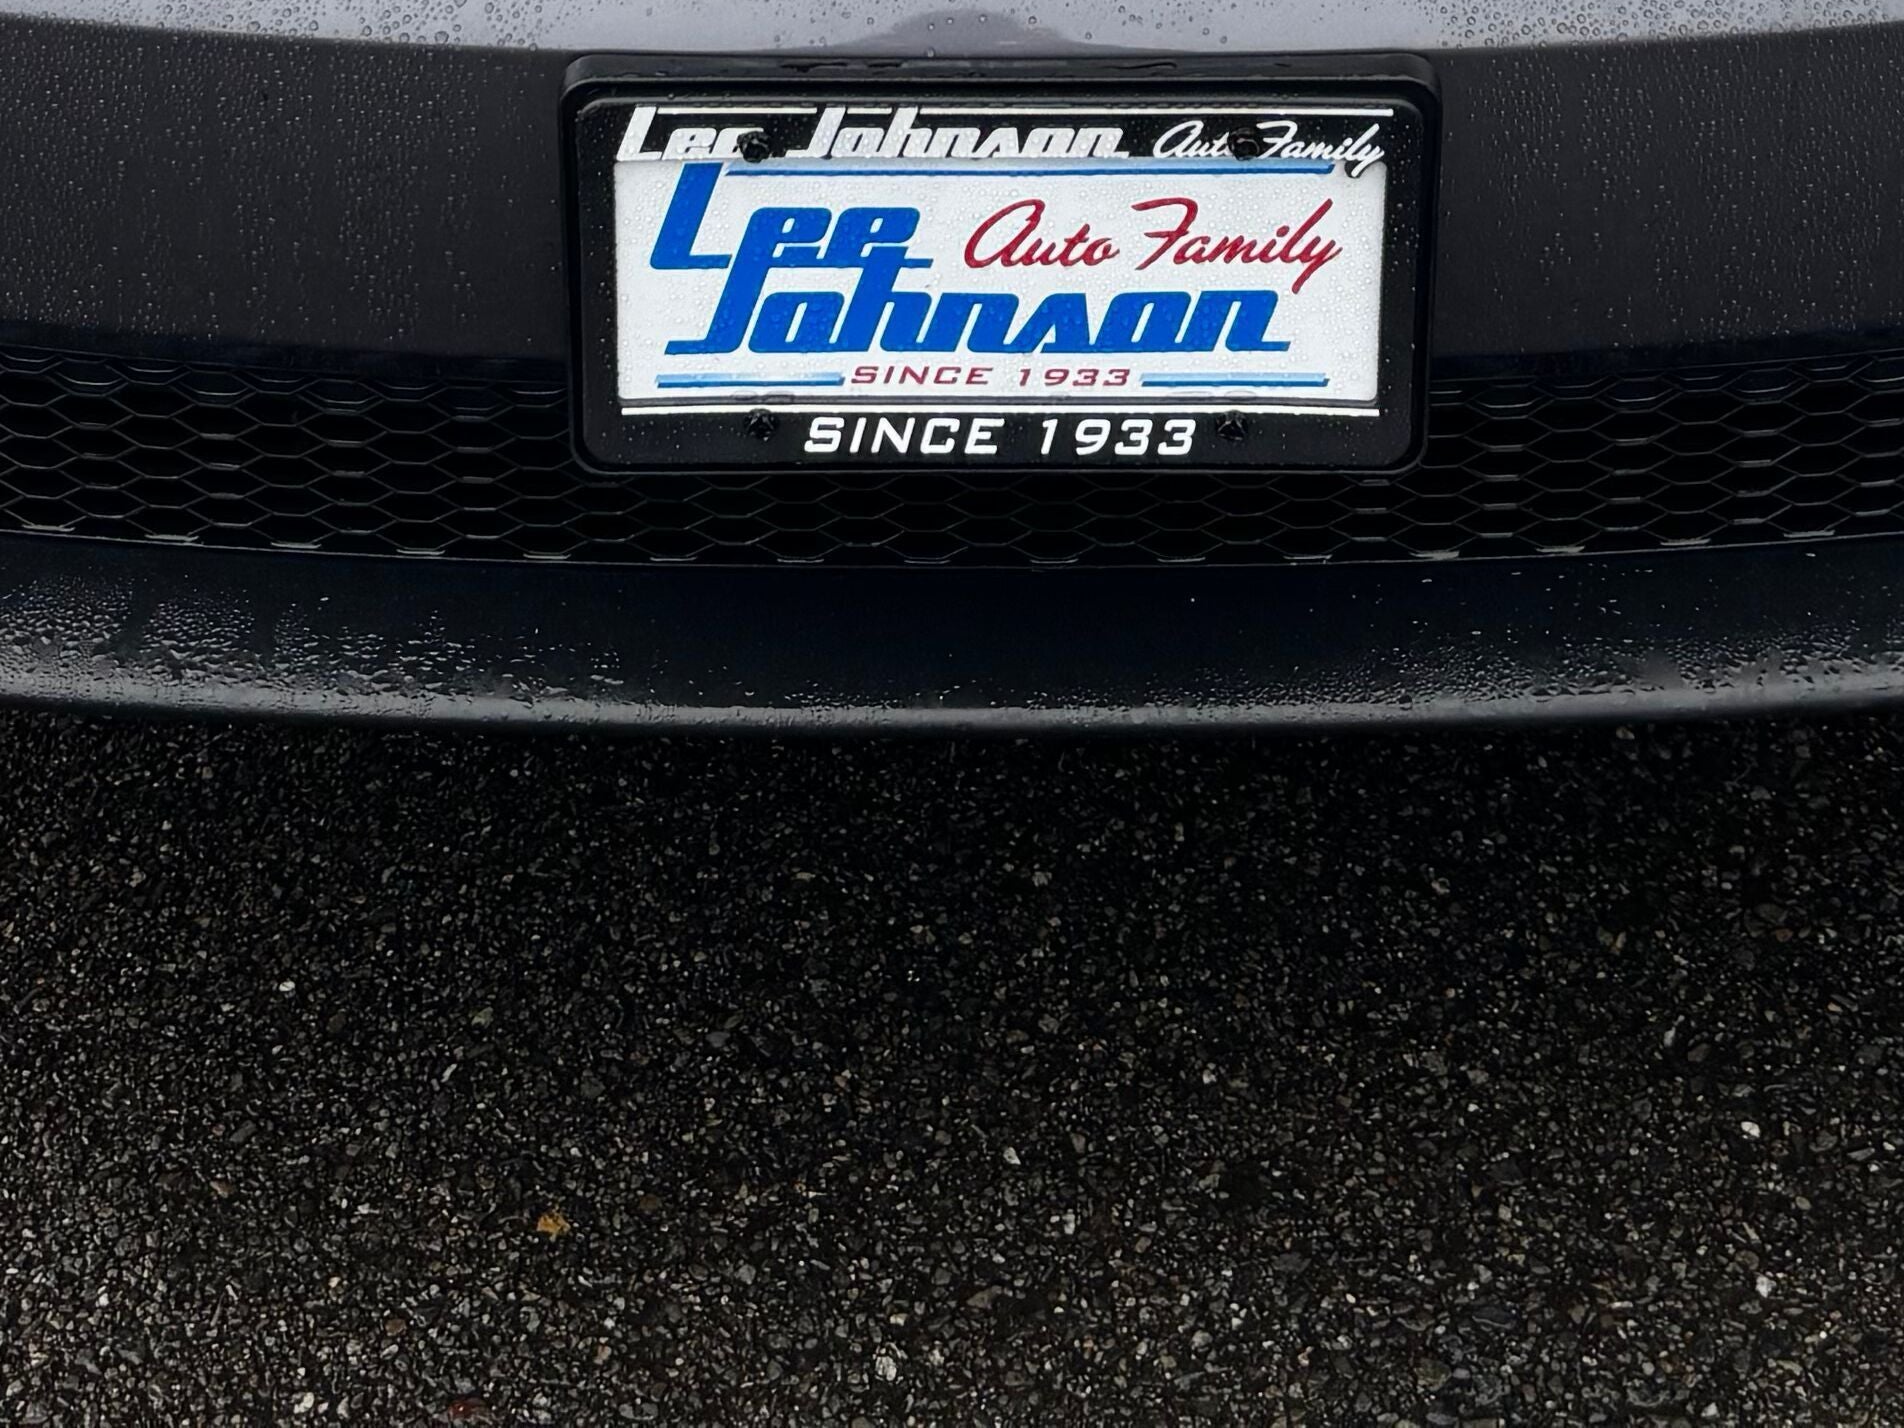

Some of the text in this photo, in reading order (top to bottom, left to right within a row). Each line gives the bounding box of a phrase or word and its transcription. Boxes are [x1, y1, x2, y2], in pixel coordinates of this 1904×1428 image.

[785, 105, 1130, 159] Johnson
[1256, 120, 1385, 178] Family
[649, 162, 1343, 294] Lee Auto Family
[664, 262, 1292, 355] Johnson
[850, 365, 1132, 388] SINCE 1933
[804, 415, 1198, 456] SINCE 1933
